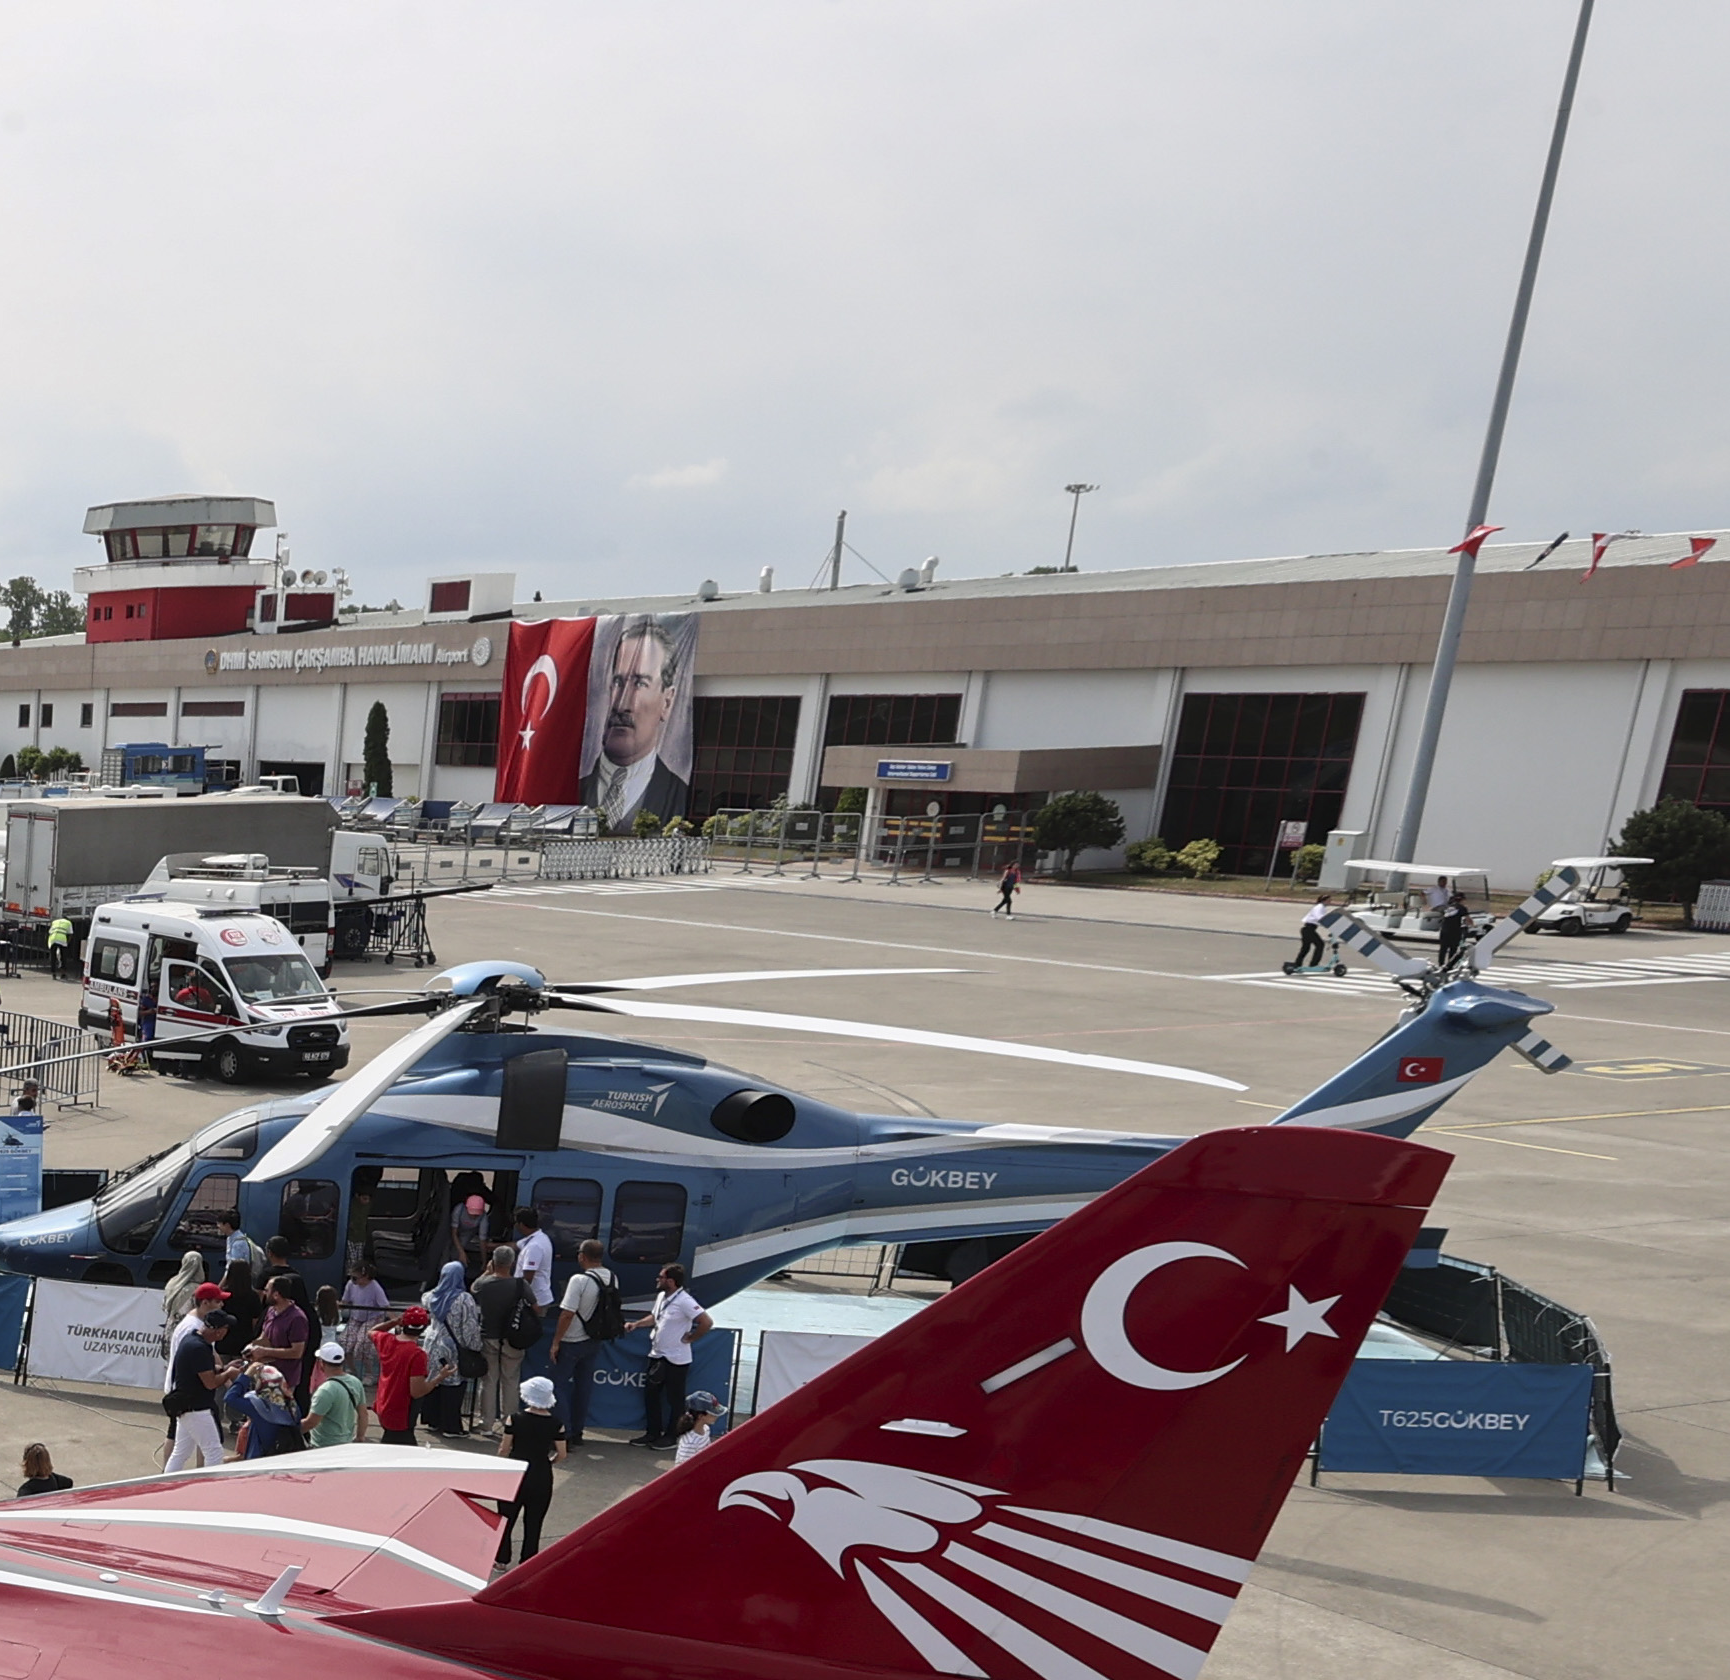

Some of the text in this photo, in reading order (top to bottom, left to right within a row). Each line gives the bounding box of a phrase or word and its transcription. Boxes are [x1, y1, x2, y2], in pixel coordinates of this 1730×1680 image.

[248, 649, 291, 671] SAMSUN
[293, 647, 356, 674] ÇARŞAMBA
[357, 641, 435, 666] HAVALİMANI
[435, 648, 469, 667] Airport
[89, 980, 128, 999] AMBULANS
[607, 1090, 654, 1103] TURKISH
[591, 1098, 649, 1112] AEROSPACE
